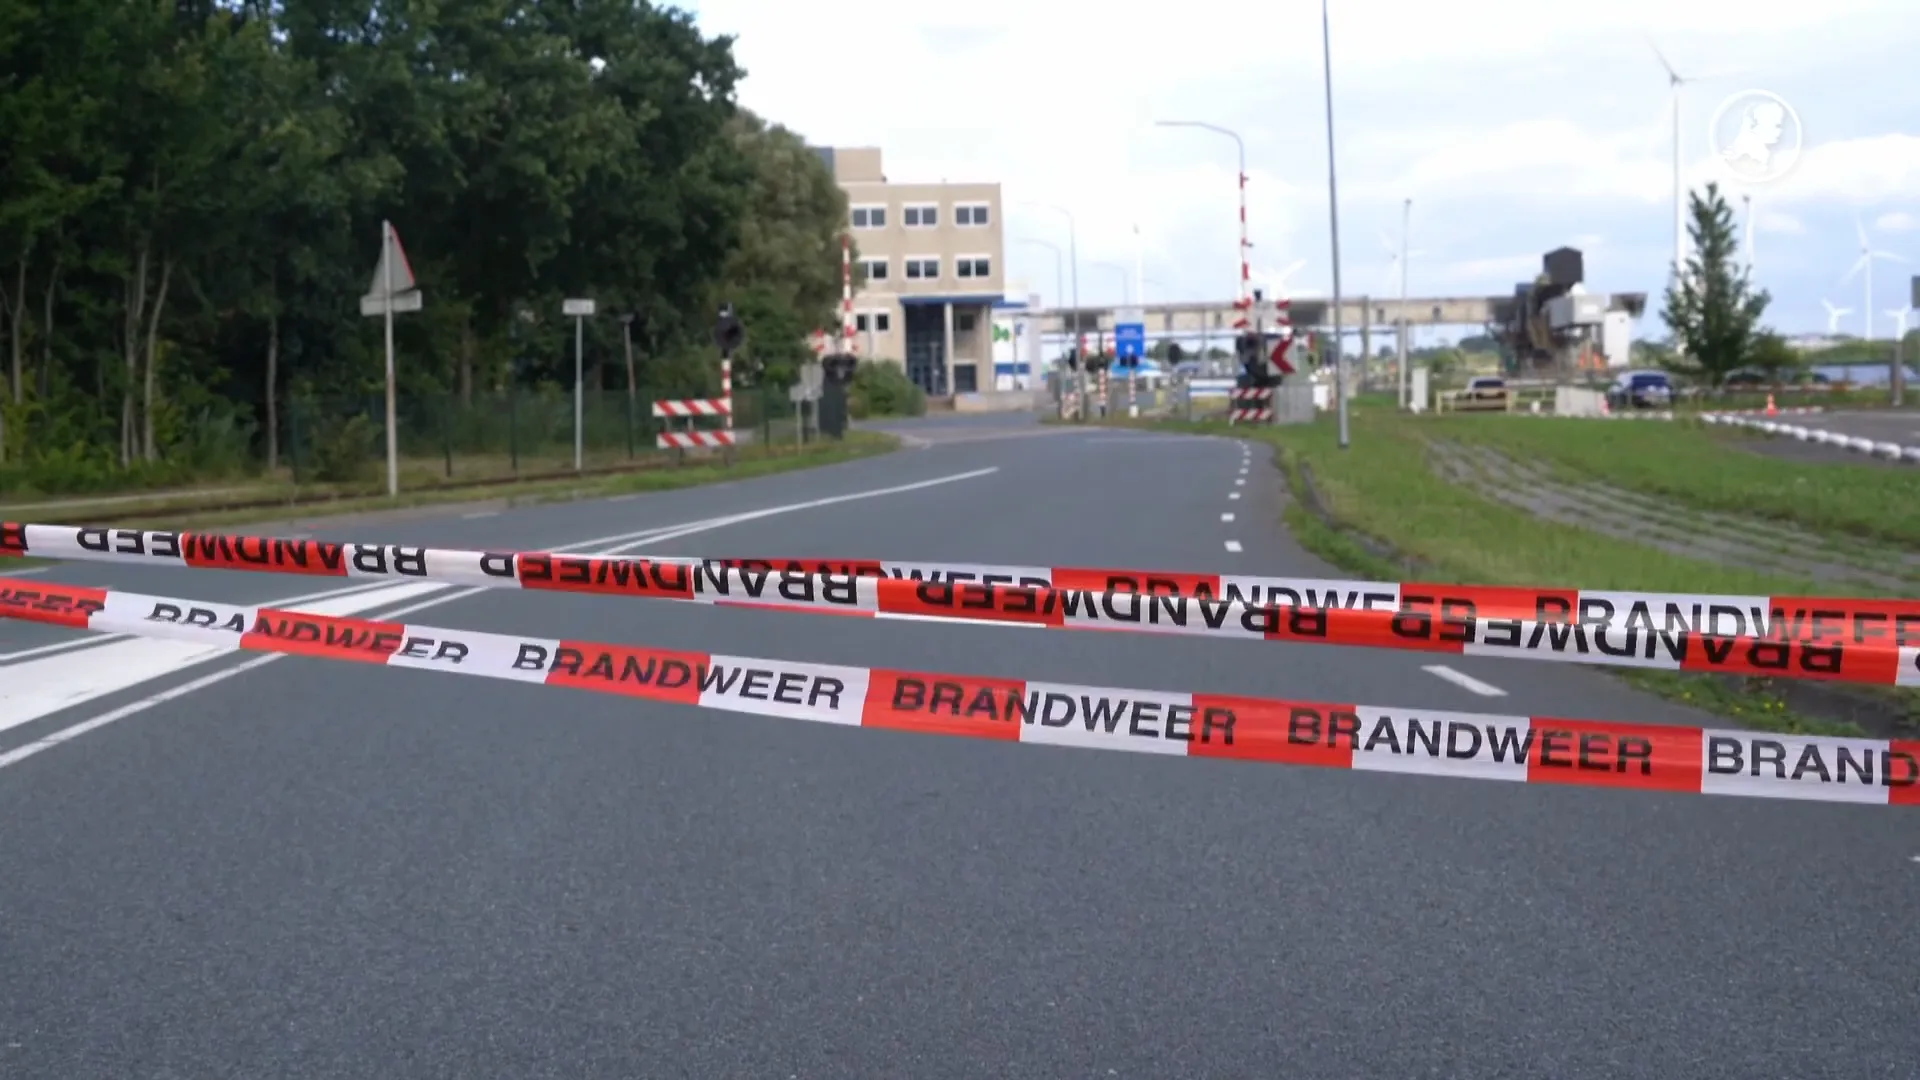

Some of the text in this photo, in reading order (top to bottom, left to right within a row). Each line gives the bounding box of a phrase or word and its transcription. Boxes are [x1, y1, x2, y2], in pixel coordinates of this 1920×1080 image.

[480, 552, 857, 606] BRANDWEER
[916, 582, 1326, 638] BRANDWEER
[512, 643, 844, 710] BRANDWEER
[891, 677, 1236, 745] BRANDWEER
[1287, 708, 1652, 775] BRANDWEER
[1708, 736, 1918, 787] BRAND
